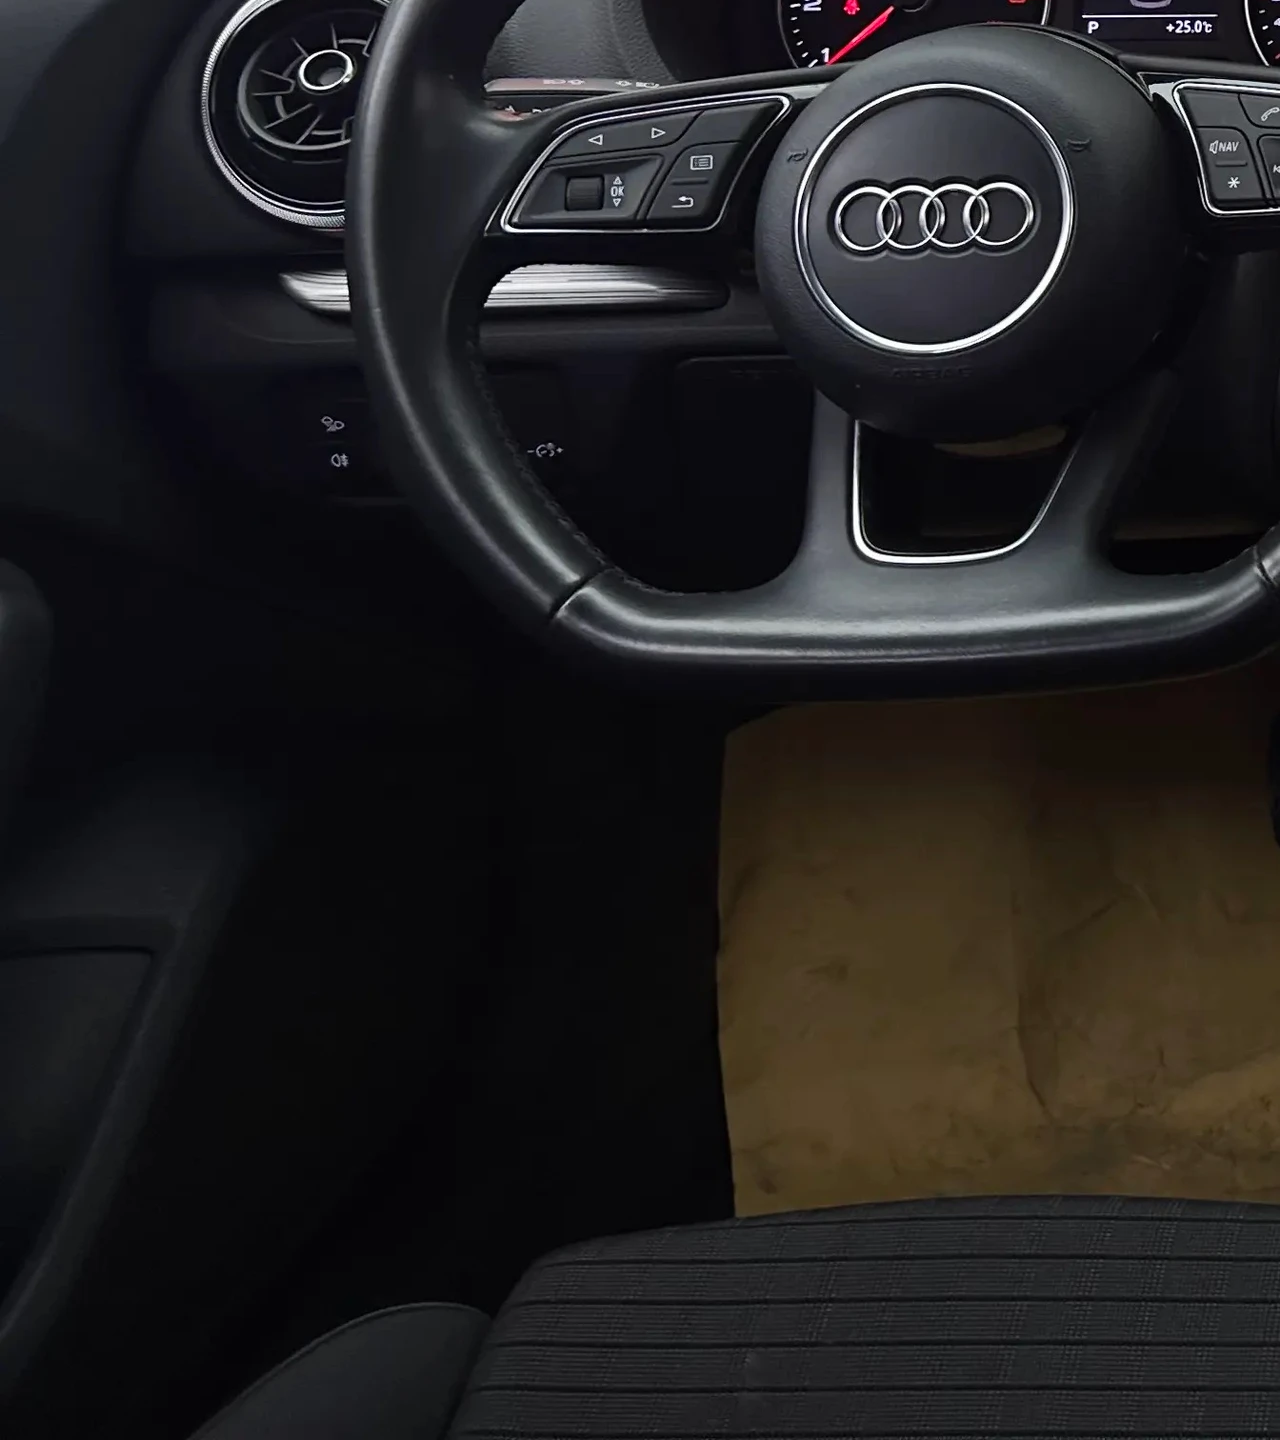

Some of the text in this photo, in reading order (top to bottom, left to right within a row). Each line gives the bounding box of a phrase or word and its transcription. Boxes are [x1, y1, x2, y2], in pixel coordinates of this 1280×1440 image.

[1087, 21, 1099, 34] P
[821, 47, 830, 62] 1
[1218, 141, 1239, 151] NAV
[610, 185, 625, 198] OK
